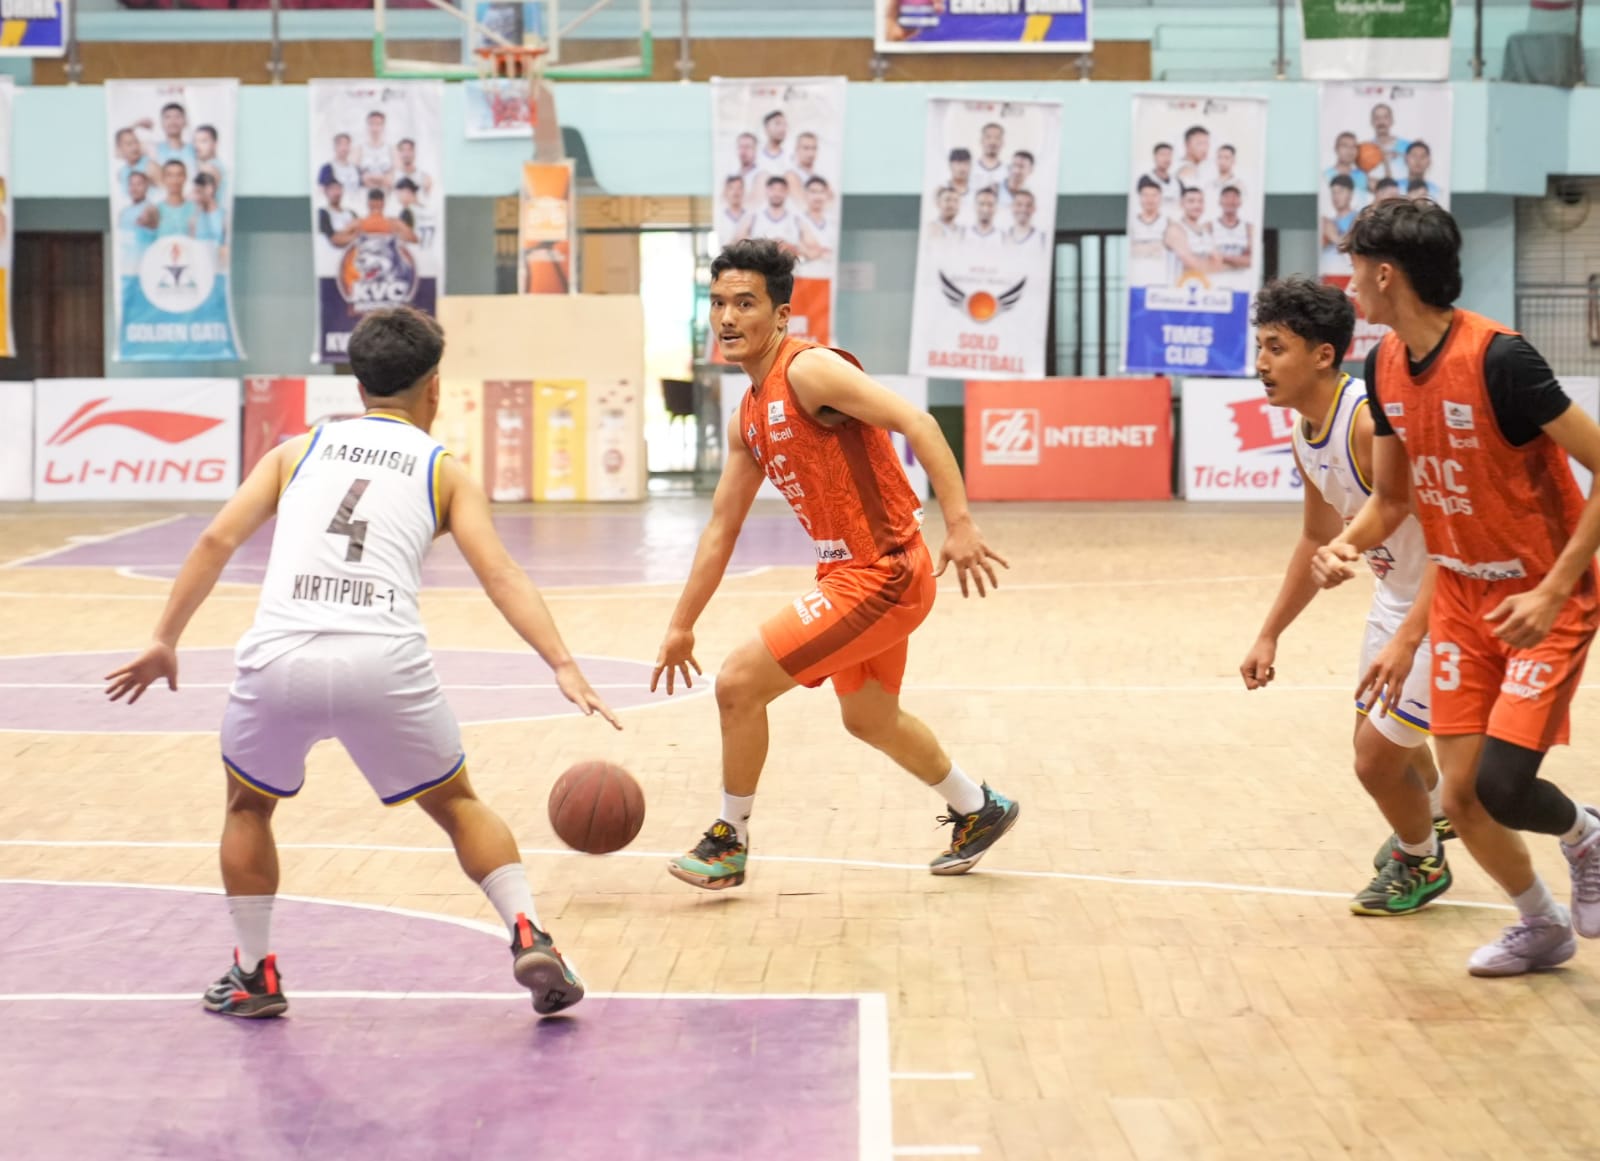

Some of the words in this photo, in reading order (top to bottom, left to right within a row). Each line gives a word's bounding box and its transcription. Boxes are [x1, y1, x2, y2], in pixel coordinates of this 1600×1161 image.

[353, 281, 409, 302] KVC
[127, 322, 187, 342] GOLDEN
[958, 333, 999, 351] SOLO
[1162, 324, 1213, 345] TIMES
[927, 350, 1025, 373] BASKETBALL
[1165, 345, 1208, 366] CLUB
[769, 427, 794, 443] Ncell
[1045, 424, 1157, 448] INTERNET
[44, 459, 227, 484] LI-NING
[320, 444, 418, 477] AASHISH
[1194, 464, 1281, 488] Ticket
[325, 478, 371, 563] 4
[292, 574, 395, 612] KIRTIPUR-1
[1435, 641, 1462, 691] 3
